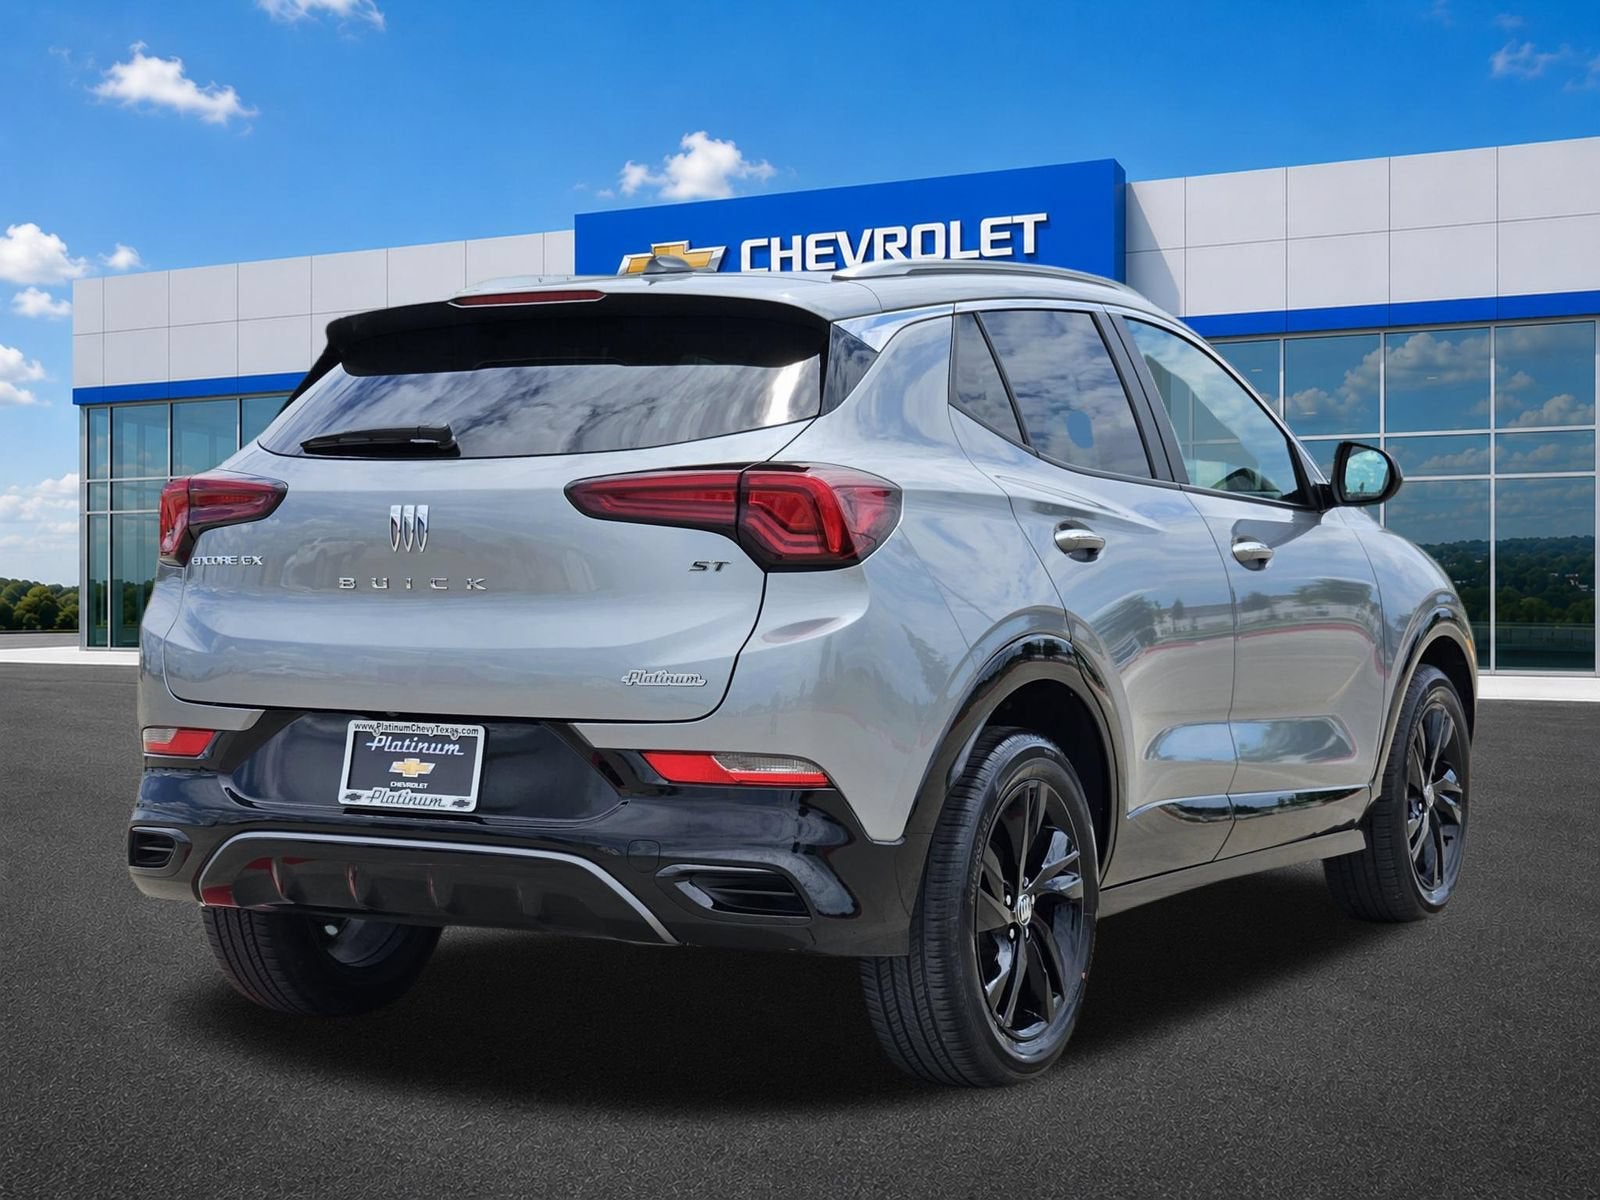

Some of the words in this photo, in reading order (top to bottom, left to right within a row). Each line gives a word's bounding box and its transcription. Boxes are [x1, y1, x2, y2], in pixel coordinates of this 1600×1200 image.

[740, 213, 1048, 273] CHEVROLET
[241, 555, 263, 566] GX
[688, 560, 731, 572] ST
[337, 577, 488, 591] BUICK
[621, 670, 706, 686] Platinum
[365, 735, 464, 755] Platinum
[390, 781, 429, 789] CHEVROLET
[365, 789, 446, 808] Platinum
